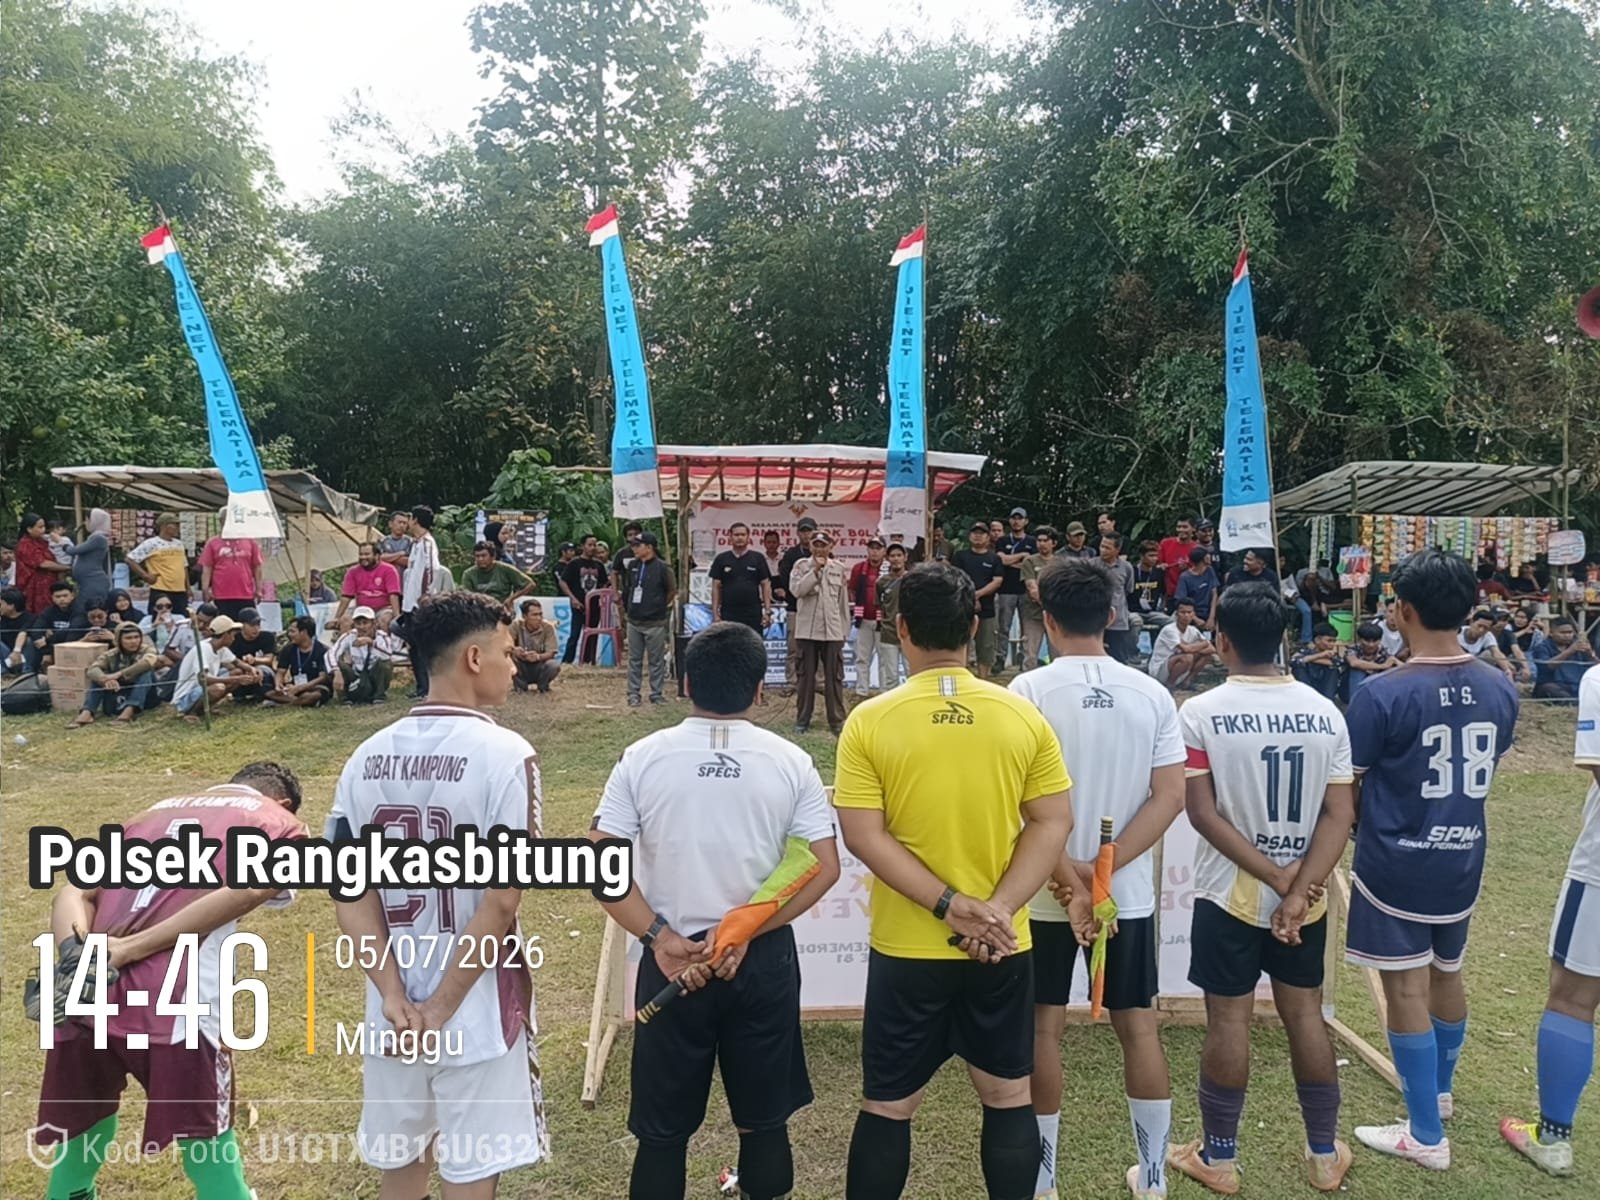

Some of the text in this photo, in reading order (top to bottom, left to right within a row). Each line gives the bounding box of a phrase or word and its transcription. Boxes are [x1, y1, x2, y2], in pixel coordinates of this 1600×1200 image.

[207, 379, 253, 479] TELEMATIKA
[620, 358, 645, 457] TELEMATIKA
[897, 382, 914, 474] TELEMATIKA
[1237, 397, 1255, 492] TELEMATIKA
[931, 713, 975, 725] SPECS
[1082, 699, 1114, 709] SPECS
[1211, 713, 1336, 735] FIKRI HAEKAL
[363, 755, 468, 782] SOBAT KAMPUNG
[697, 766, 741, 778] SPECS
[1261, 745, 1304, 824] 11
[1421, 721, 1498, 799] 38
